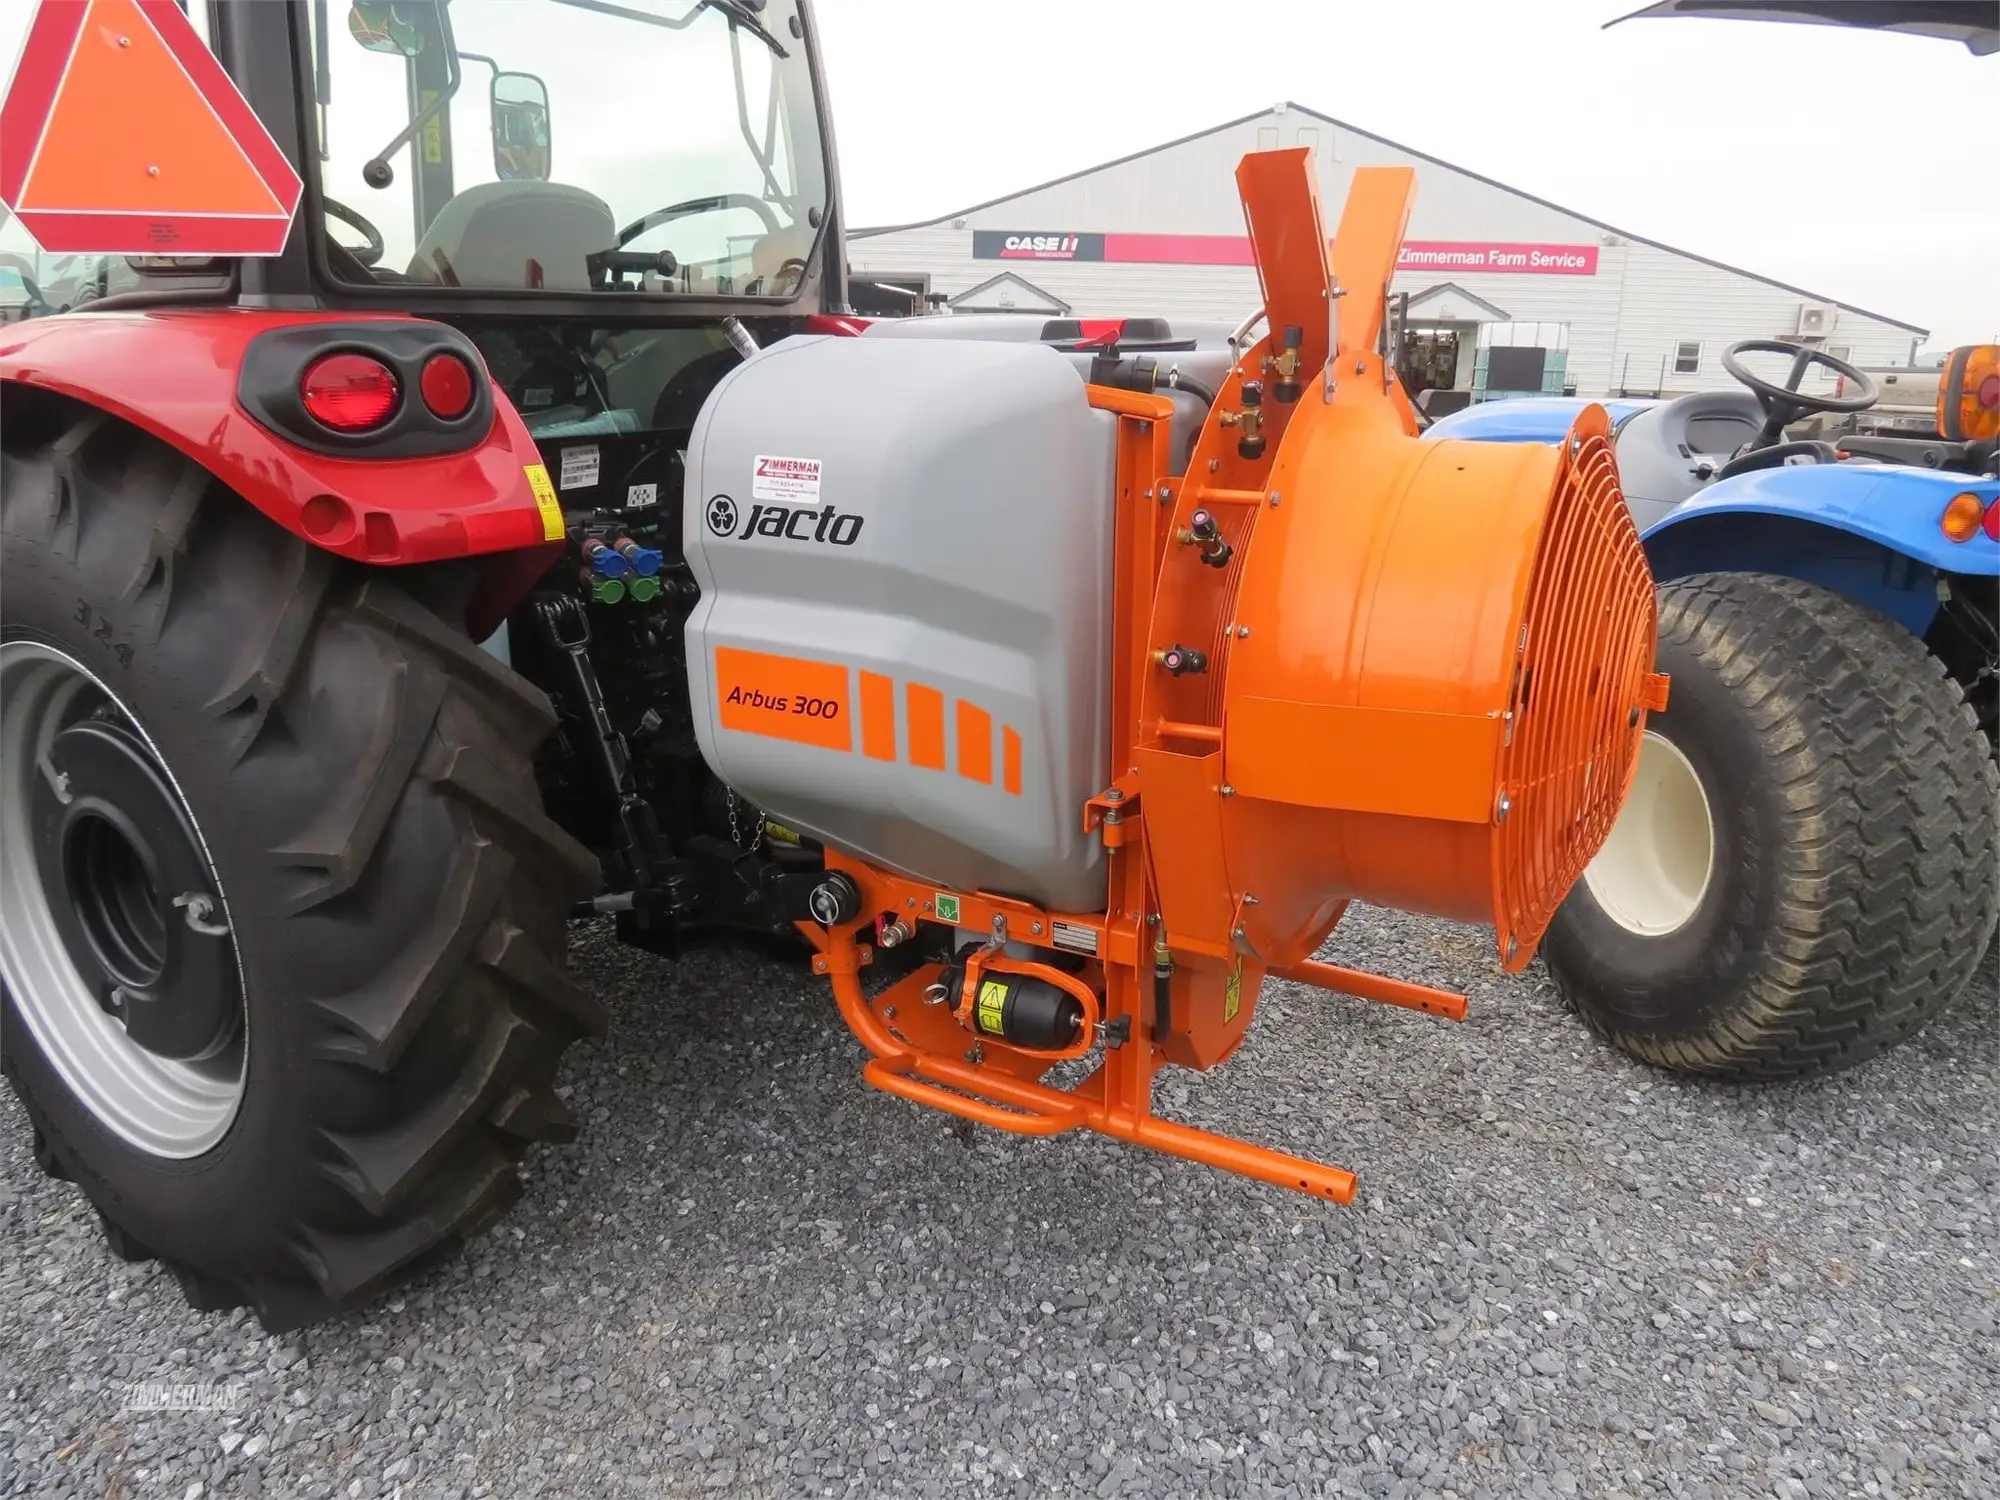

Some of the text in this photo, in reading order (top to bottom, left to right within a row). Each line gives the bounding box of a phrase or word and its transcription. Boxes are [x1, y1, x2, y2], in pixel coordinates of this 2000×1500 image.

[1004, 236, 1060, 251] CASE
[1398, 248, 1586, 268] Zimmerman Farm Service
[757, 459, 820, 476] ZIMMERMAN
[738, 505, 864, 546] jacto
[726, 686, 839, 719] Arbus 300
